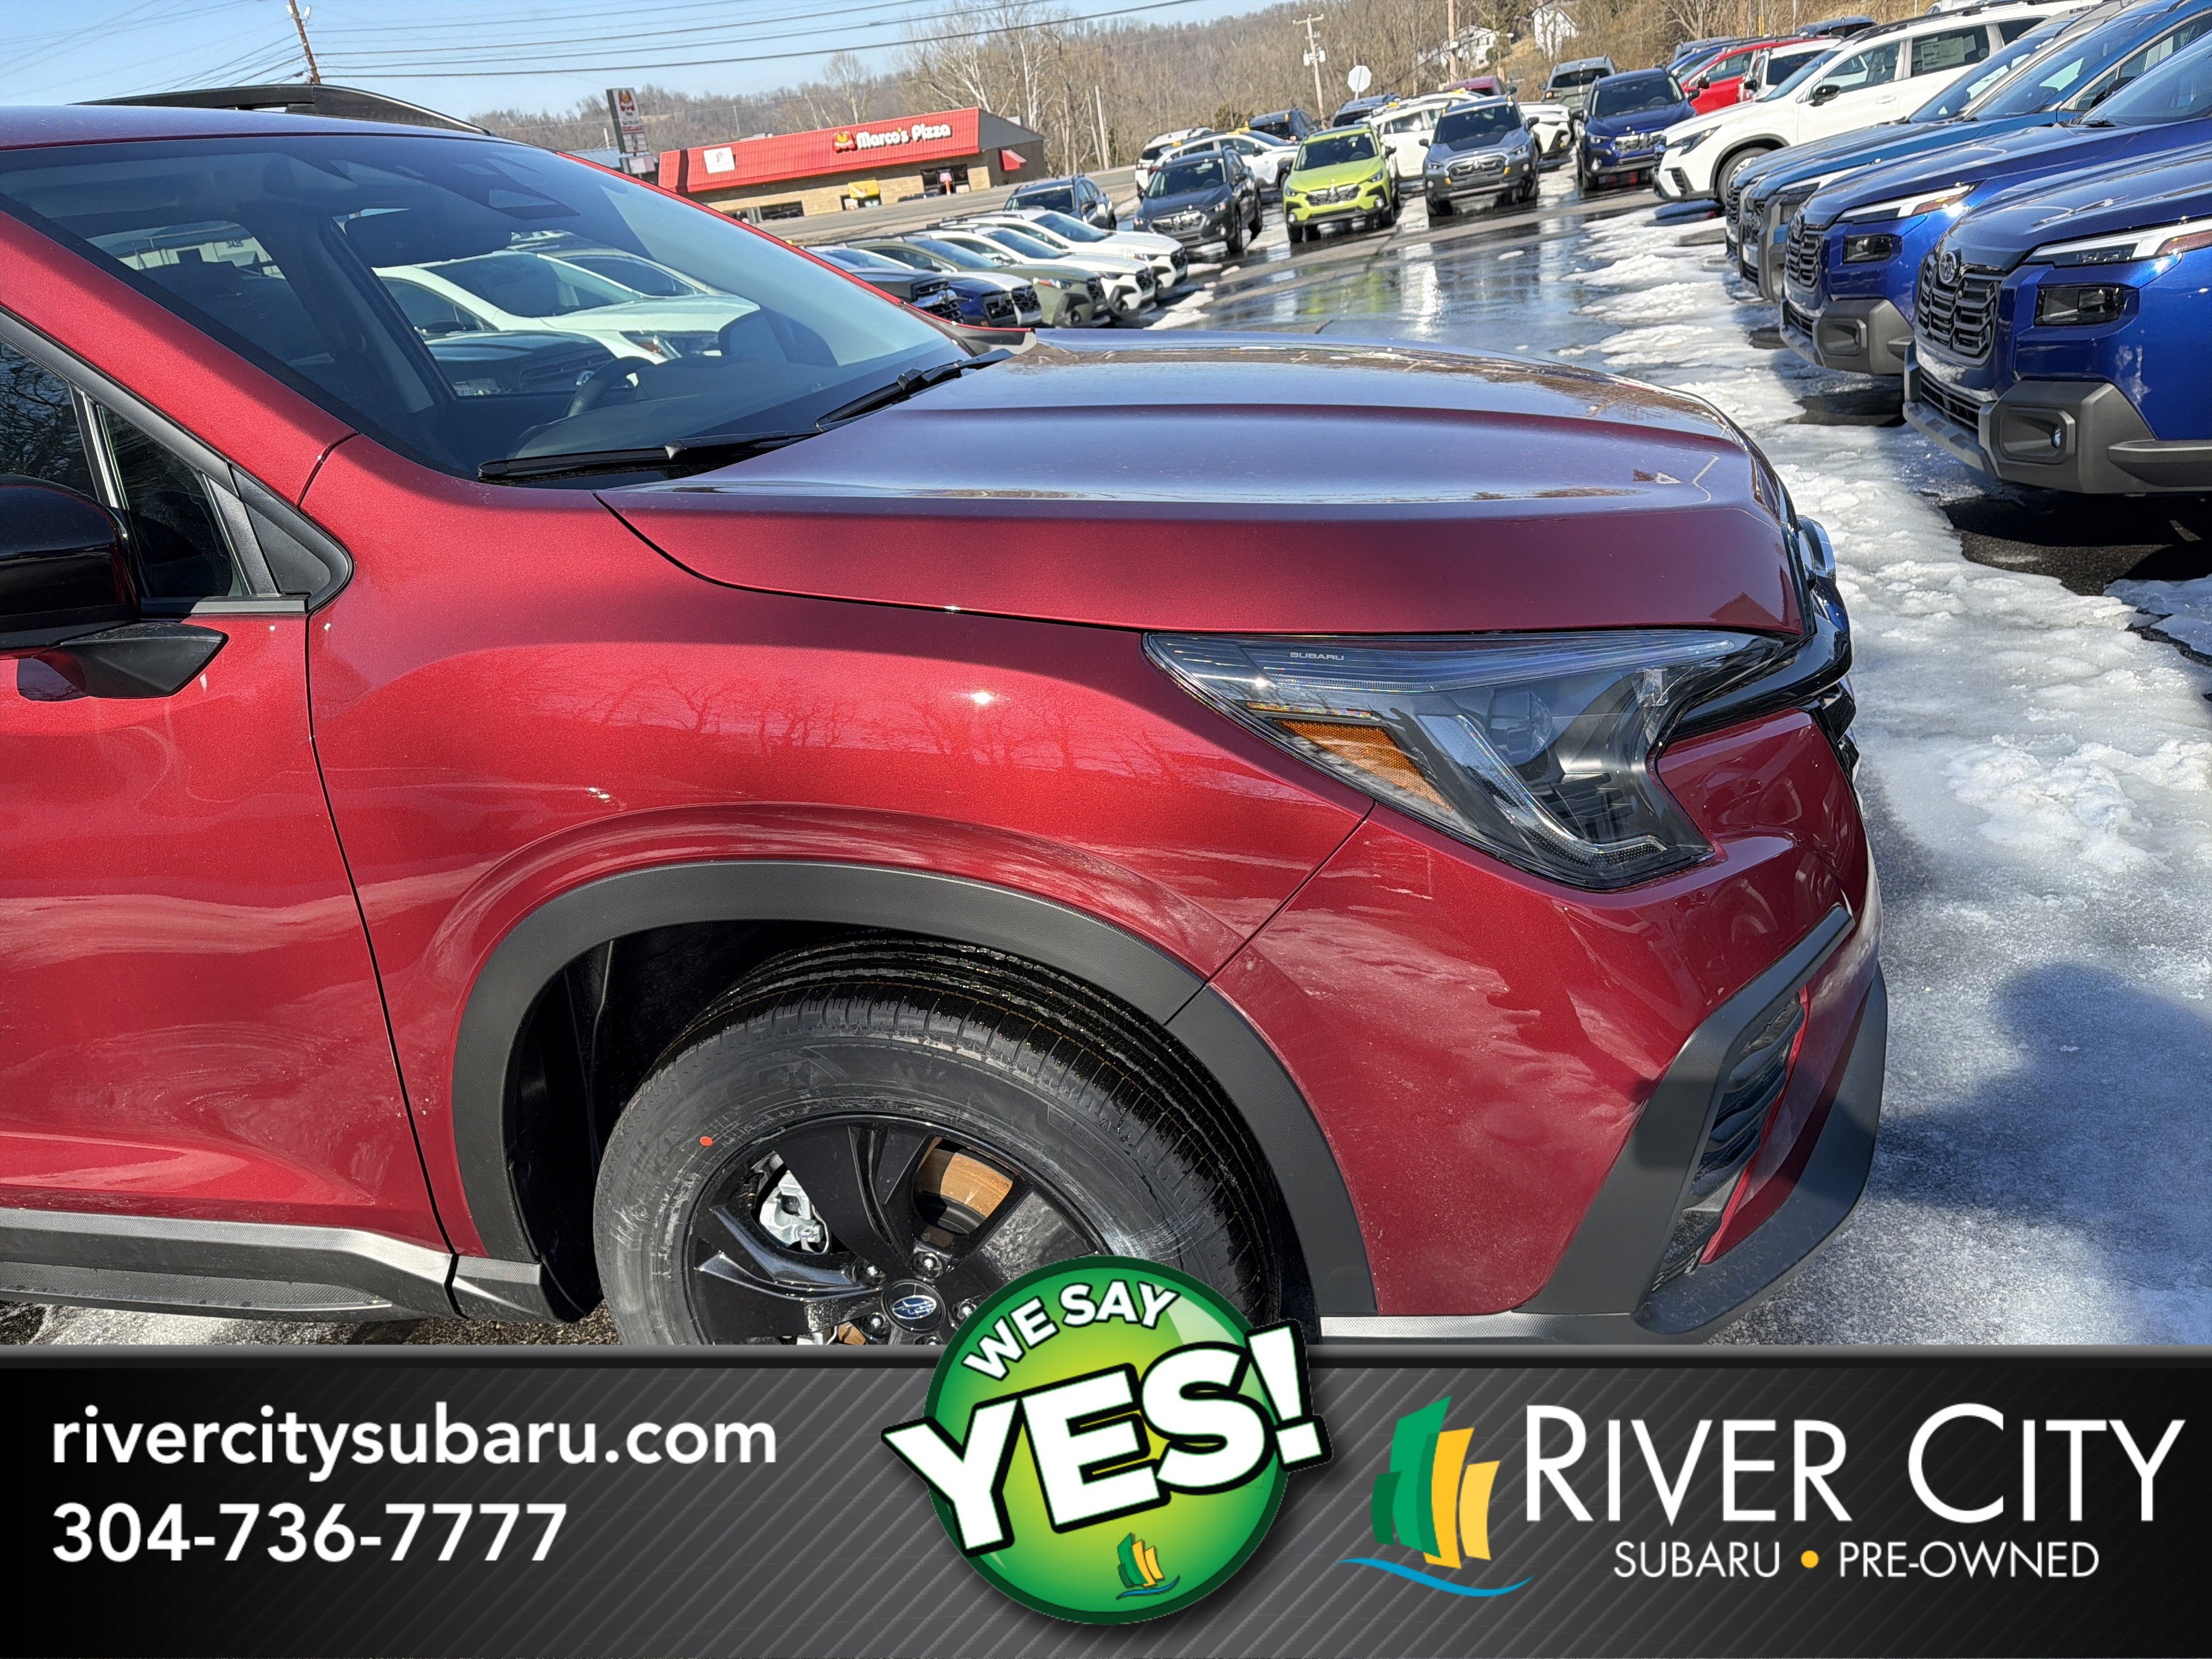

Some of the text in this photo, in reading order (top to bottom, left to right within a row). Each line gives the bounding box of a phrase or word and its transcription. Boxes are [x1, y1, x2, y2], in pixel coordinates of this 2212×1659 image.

[856, 123, 951, 149] Marco's Pizza
[1289, 652, 1344, 661] SUBARU
